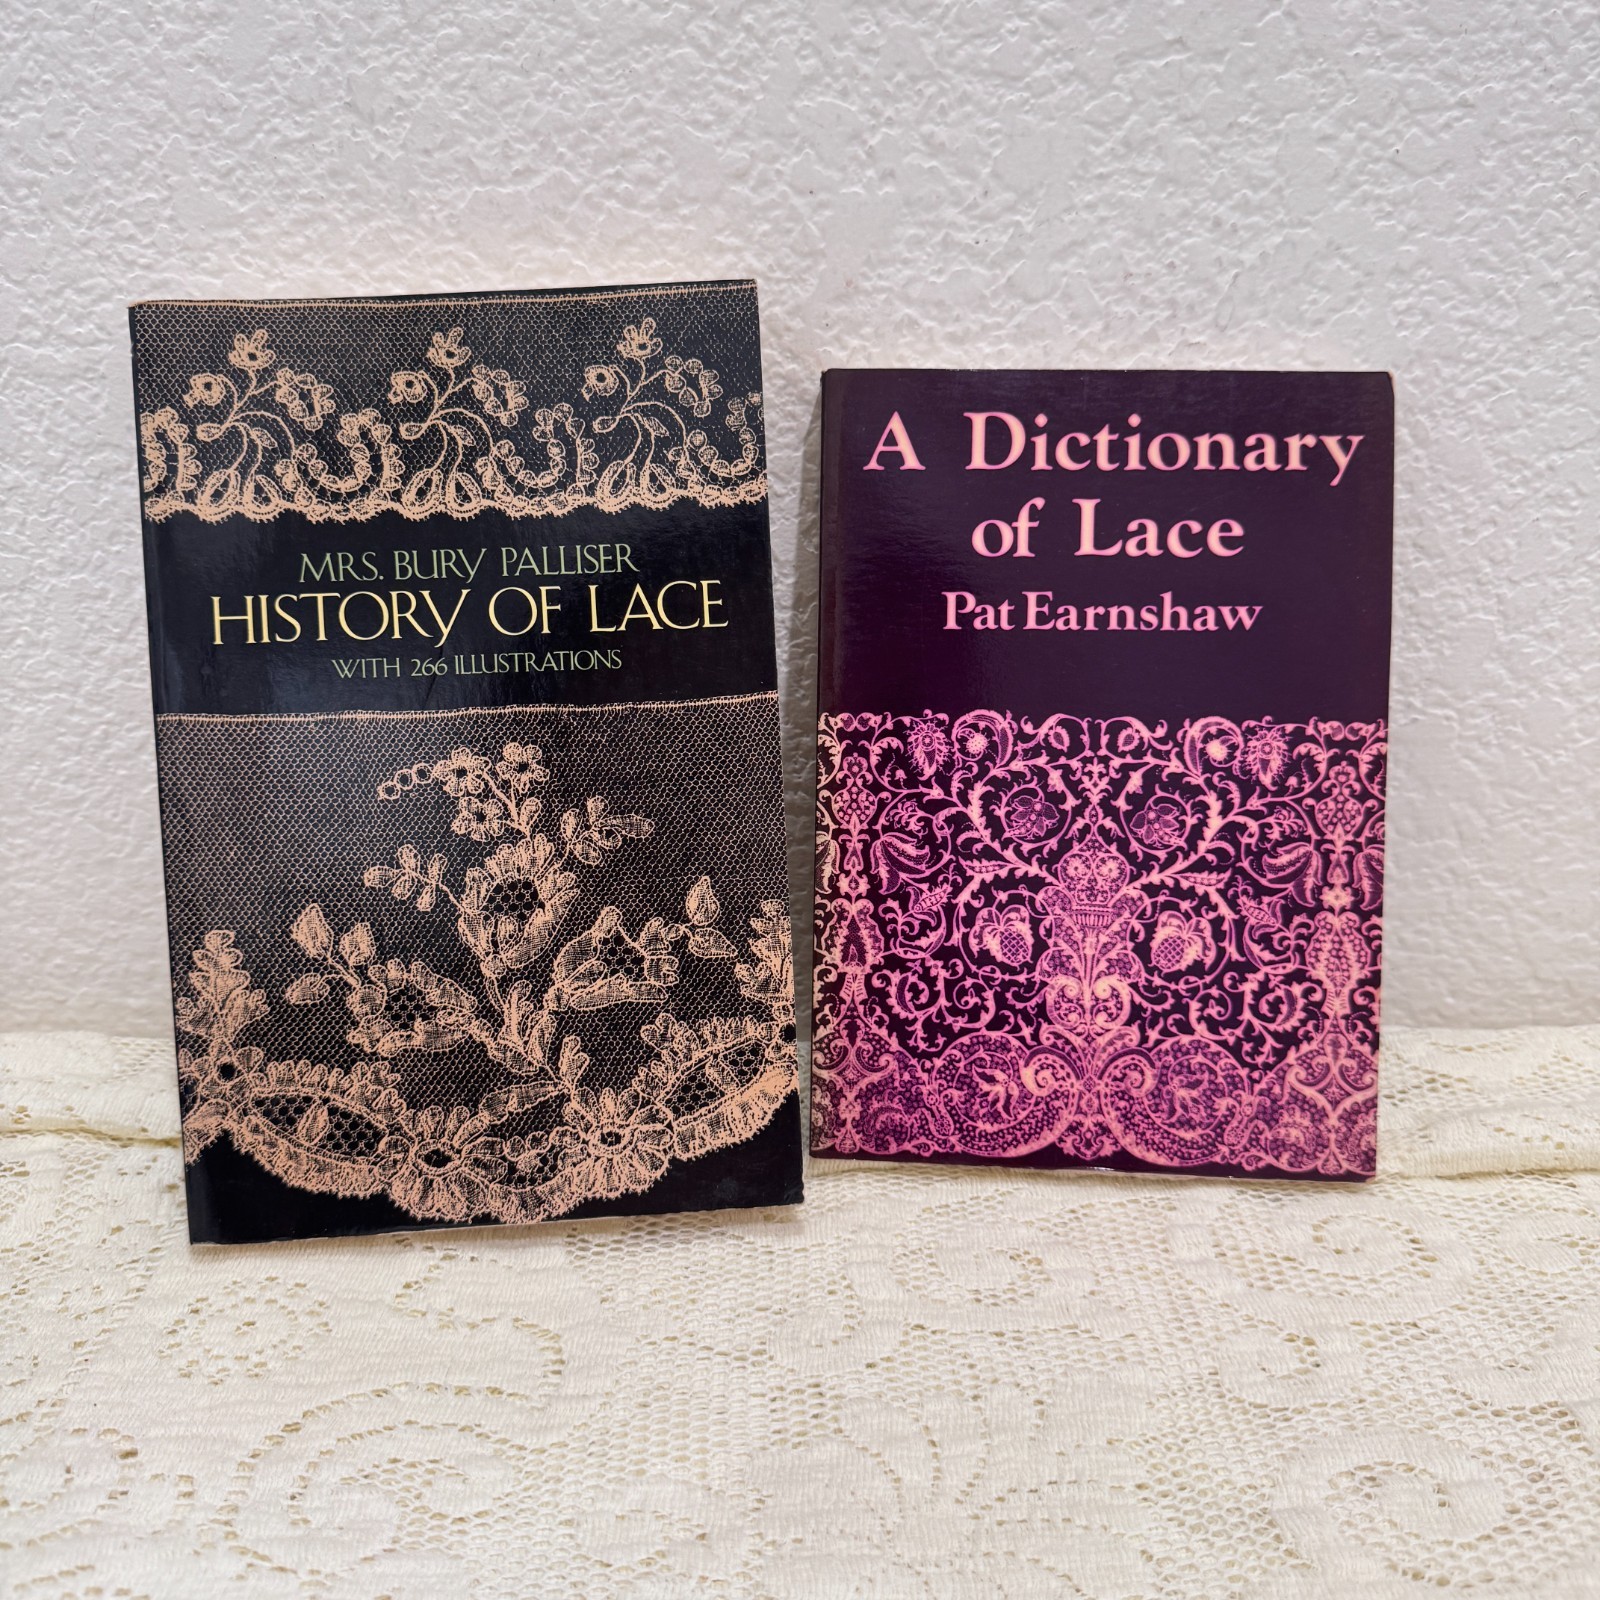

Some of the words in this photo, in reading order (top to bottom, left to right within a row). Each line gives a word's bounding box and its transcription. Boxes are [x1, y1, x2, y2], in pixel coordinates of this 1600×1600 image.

[862, 411, 926, 471] A
[962, 411, 1365, 487] Dictionary
[971, 496, 1046, 558] of
[1071, 498, 1245, 558] Lace
[299, 551, 385, 582] MRS.
[394, 547, 487, 584] BURY
[501, 543, 640, 577] PALLISER
[211, 588, 471, 648] HISTORY
[488, 585, 562, 636] OF
[588, 580, 729, 633] LACE
[941, 591, 1015, 631] Pat
[1021, 590, 1263, 632] Earnshaw
[331, 657, 401, 679] WITH
[411, 658, 448, 678] 266
[454, 649, 622, 676] ILLUSTRATIONS
